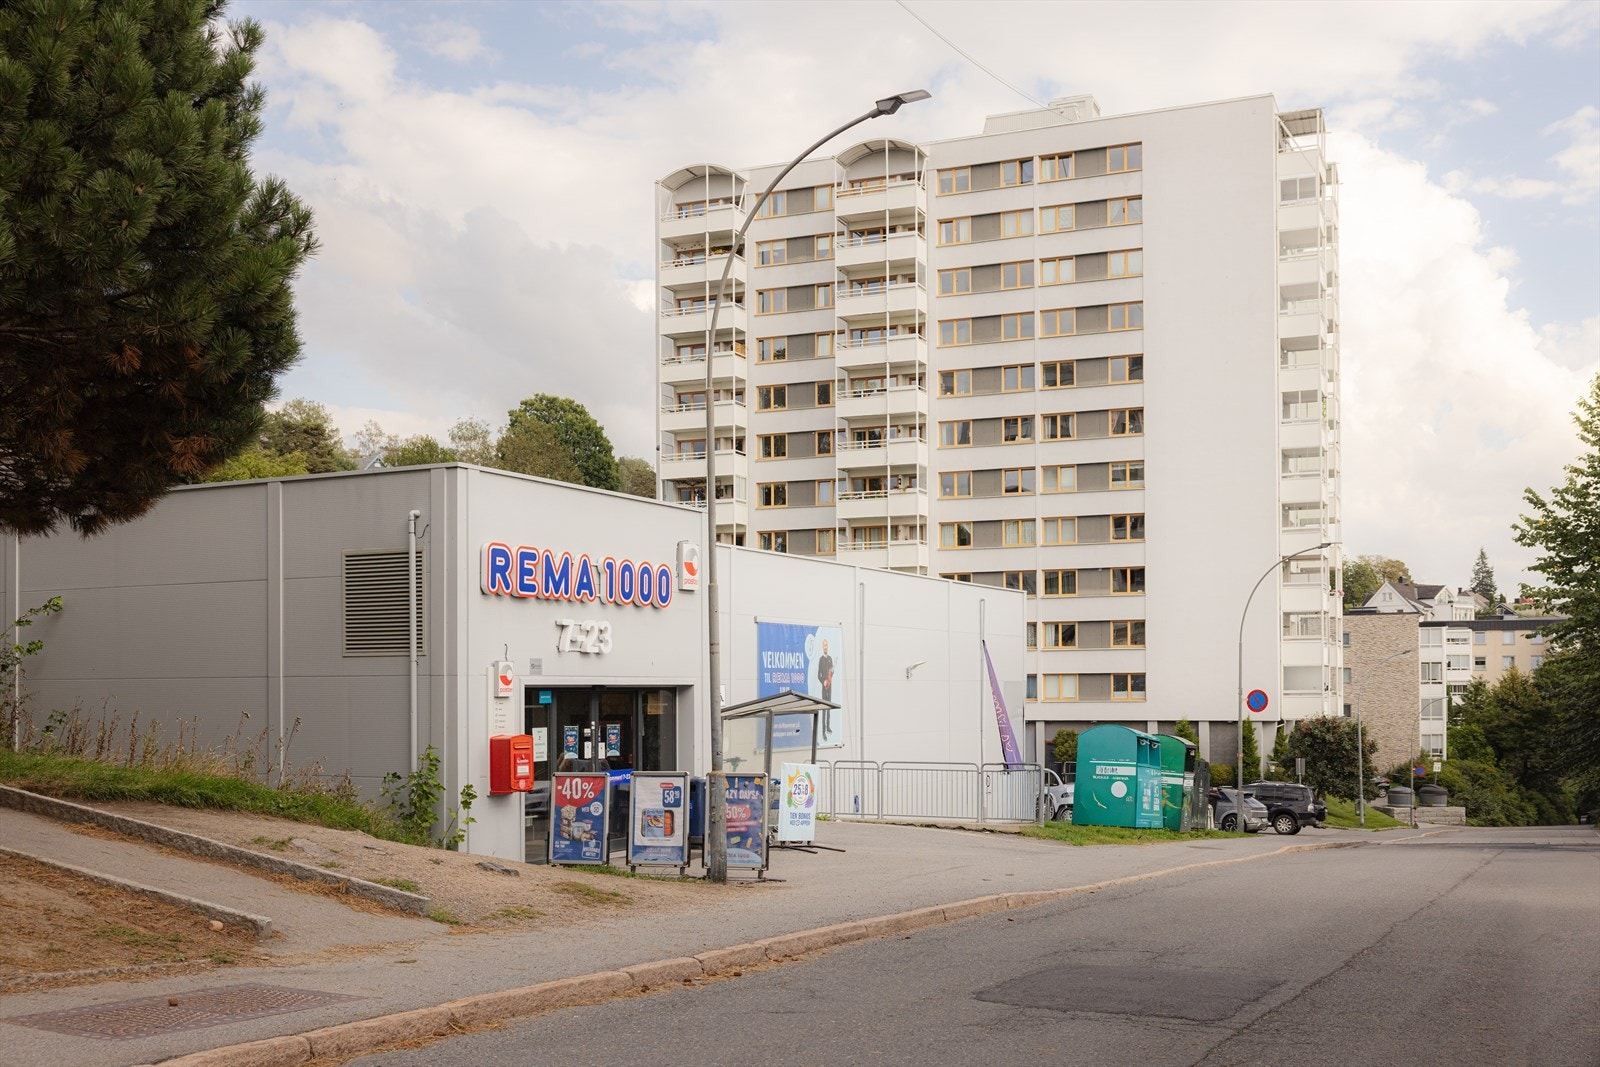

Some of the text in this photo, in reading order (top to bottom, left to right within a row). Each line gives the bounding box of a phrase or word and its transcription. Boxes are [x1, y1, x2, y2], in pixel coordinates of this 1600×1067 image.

[486, 541, 673, 609] REMA 1000
[555, 618, 613, 654] 7-23
[762, 651, 805, 669] VELKOMMEN
[772, 672, 791, 684] REMA
[557, 777, 595, 800] -40%
[726, 789, 738, 799] AZY
[793, 783, 809, 796] 25 8
[664, 790, 675, 804] 58
